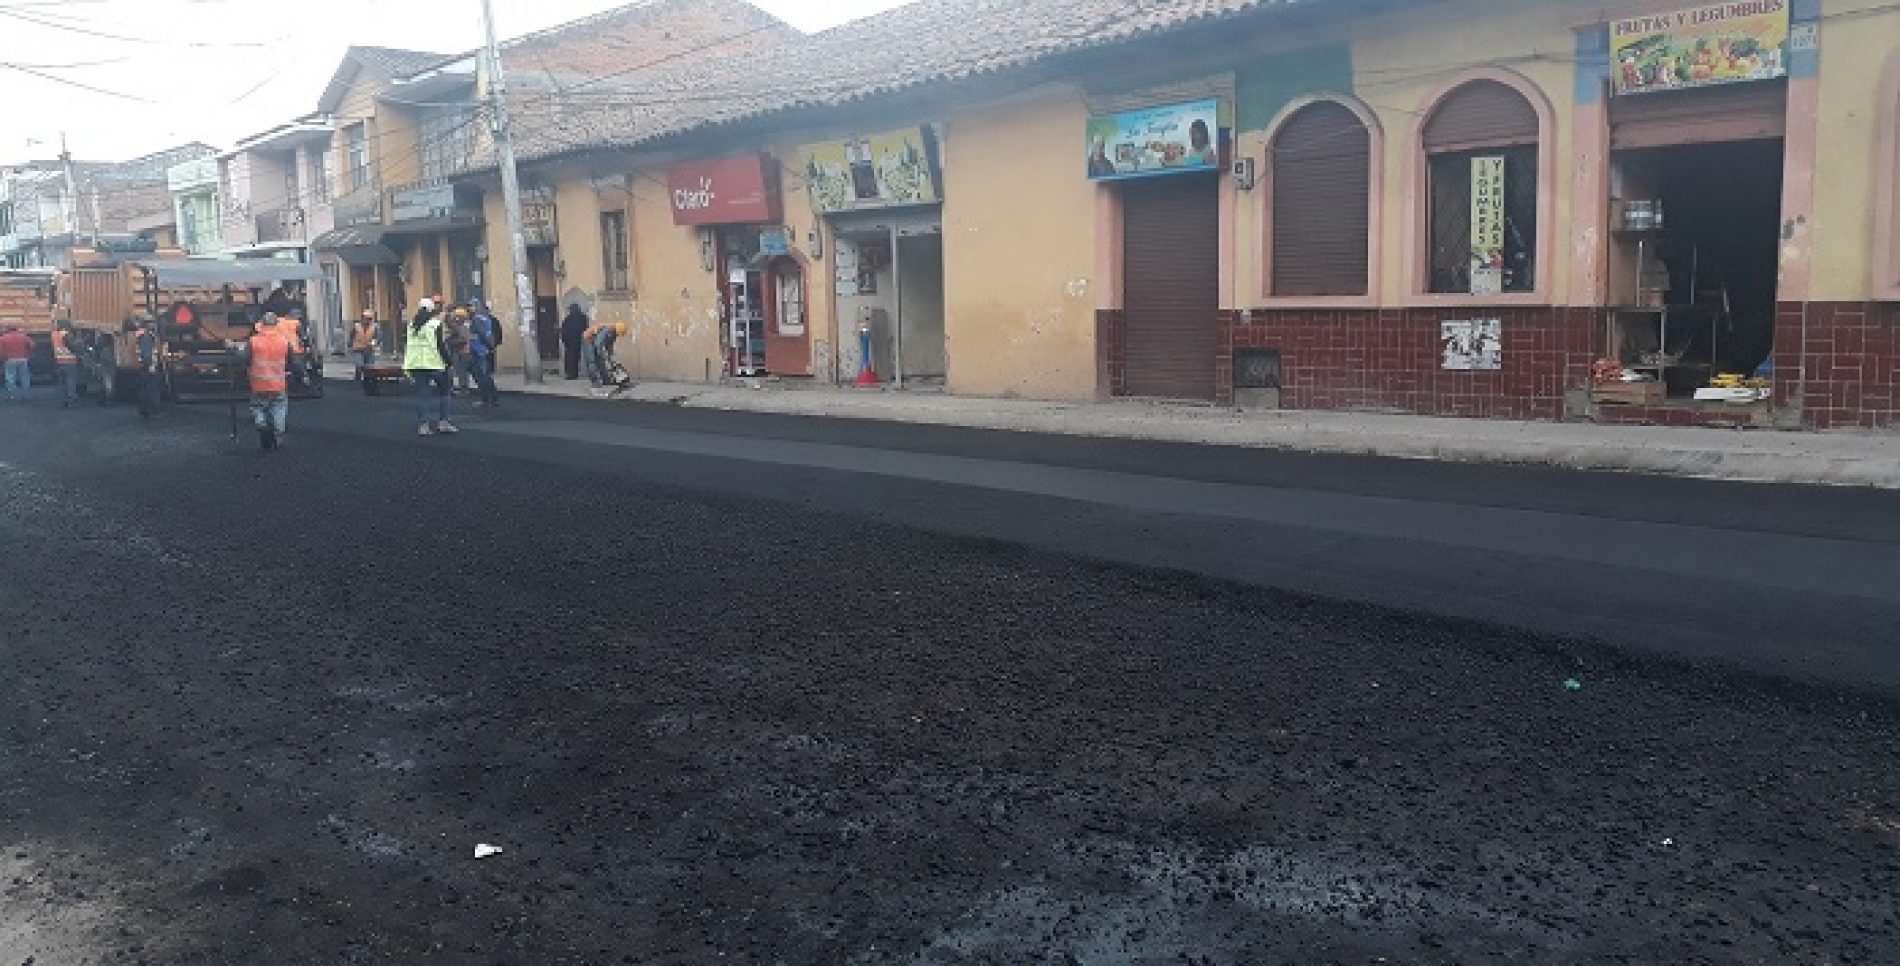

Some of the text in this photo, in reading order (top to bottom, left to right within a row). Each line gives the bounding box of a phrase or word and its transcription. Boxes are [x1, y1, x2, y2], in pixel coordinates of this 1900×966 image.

[1616, 0, 1784, 36] FRUTAS Y LEGUMBRES
[673, 186, 709, 210] Claro
